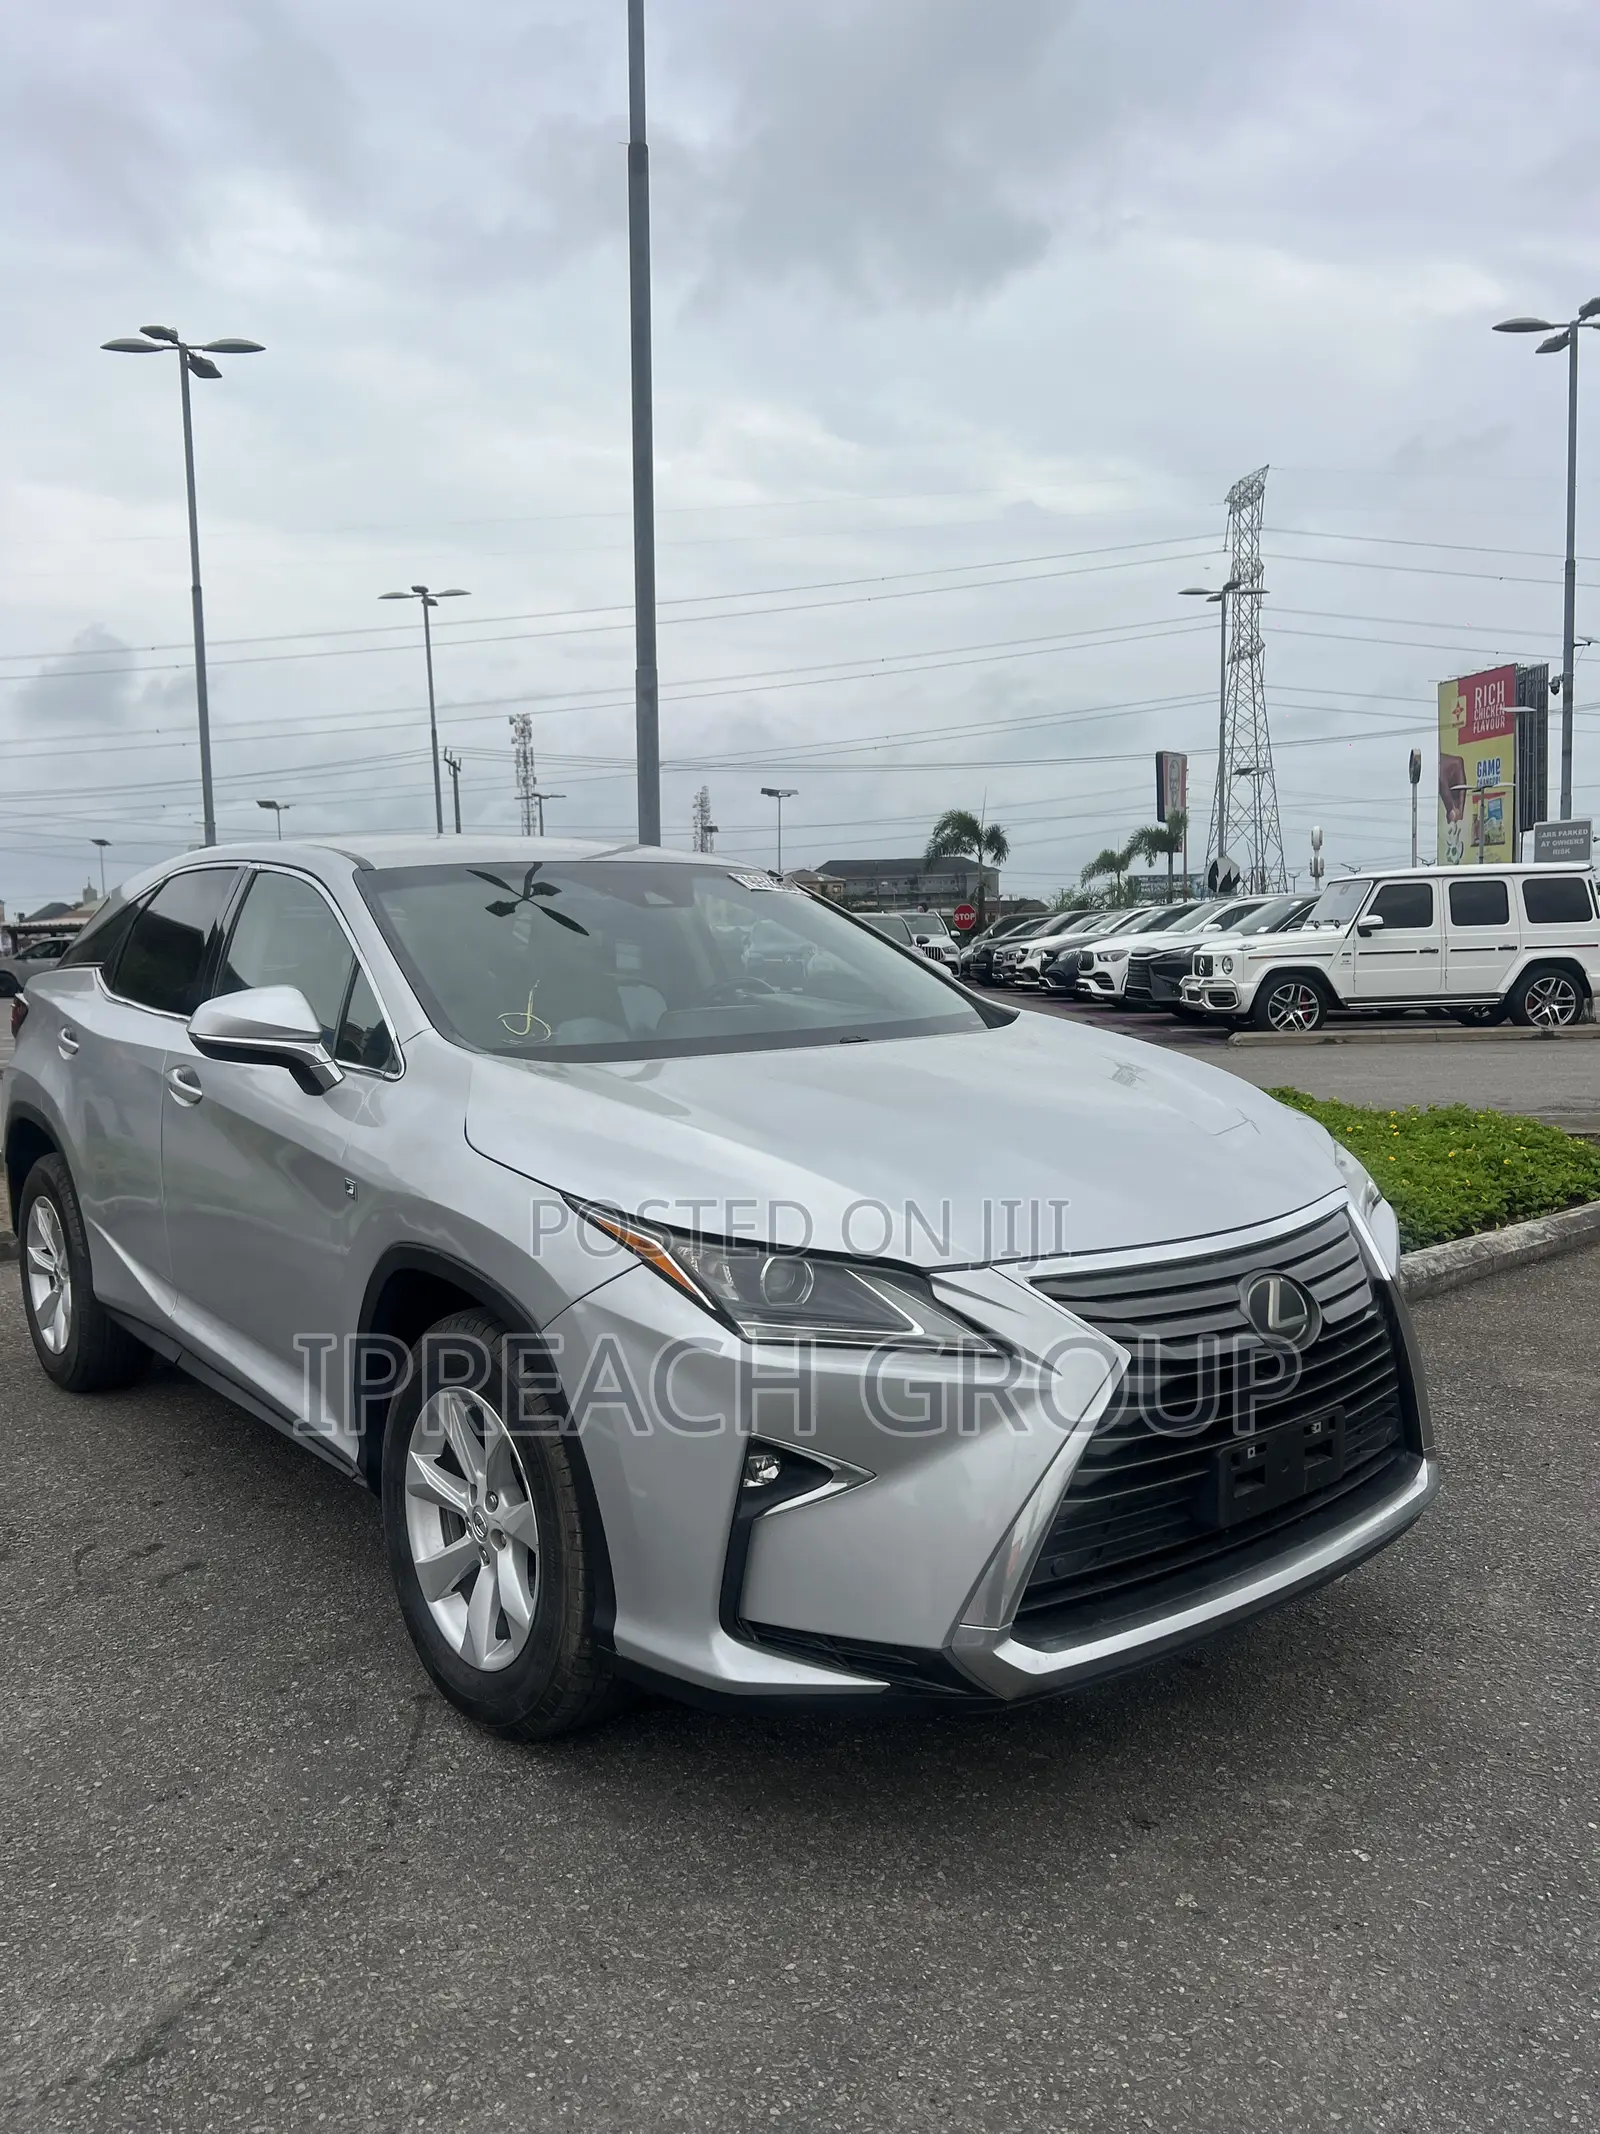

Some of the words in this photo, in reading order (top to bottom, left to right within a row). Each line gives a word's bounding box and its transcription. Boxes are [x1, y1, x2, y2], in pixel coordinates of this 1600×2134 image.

[1474, 680, 1505, 709] RICH
[1473, 703, 1505, 721] CHICKEN
[1473, 716, 1505, 734] FLAVOUR
[1558, 828, 1588, 837] PARKED
[1540, 840, 1551, 848] AT
[954, 912, 976, 921] STOP
